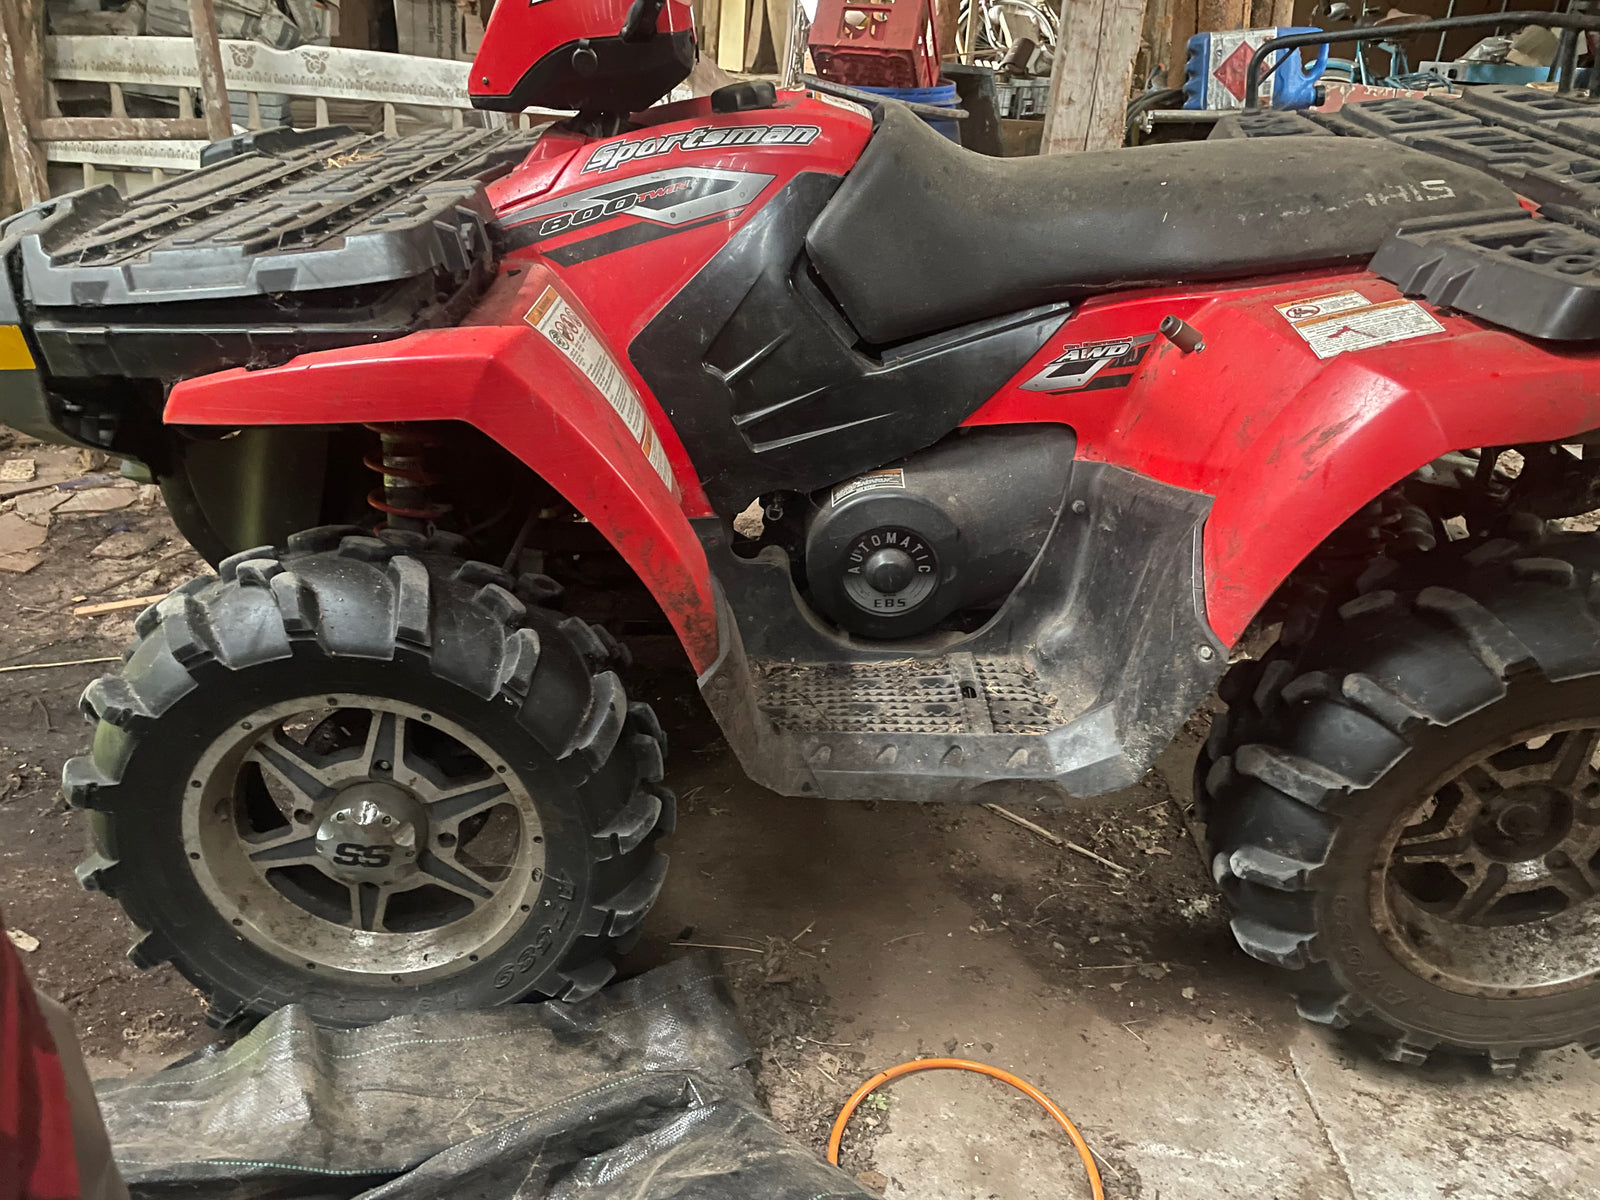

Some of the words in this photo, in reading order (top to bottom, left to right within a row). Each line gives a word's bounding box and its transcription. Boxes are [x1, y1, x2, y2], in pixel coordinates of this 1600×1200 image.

[580, 125, 822, 174] Sportsman
[539, 192, 638, 236] 800
[638, 179, 690, 202] TWIN
[1055, 343, 1131, 363] AWD
[847, 531, 932, 575] AUTOMATIC
[873, 598, 906, 608] EBS
[333, 842, 394, 868] SS
